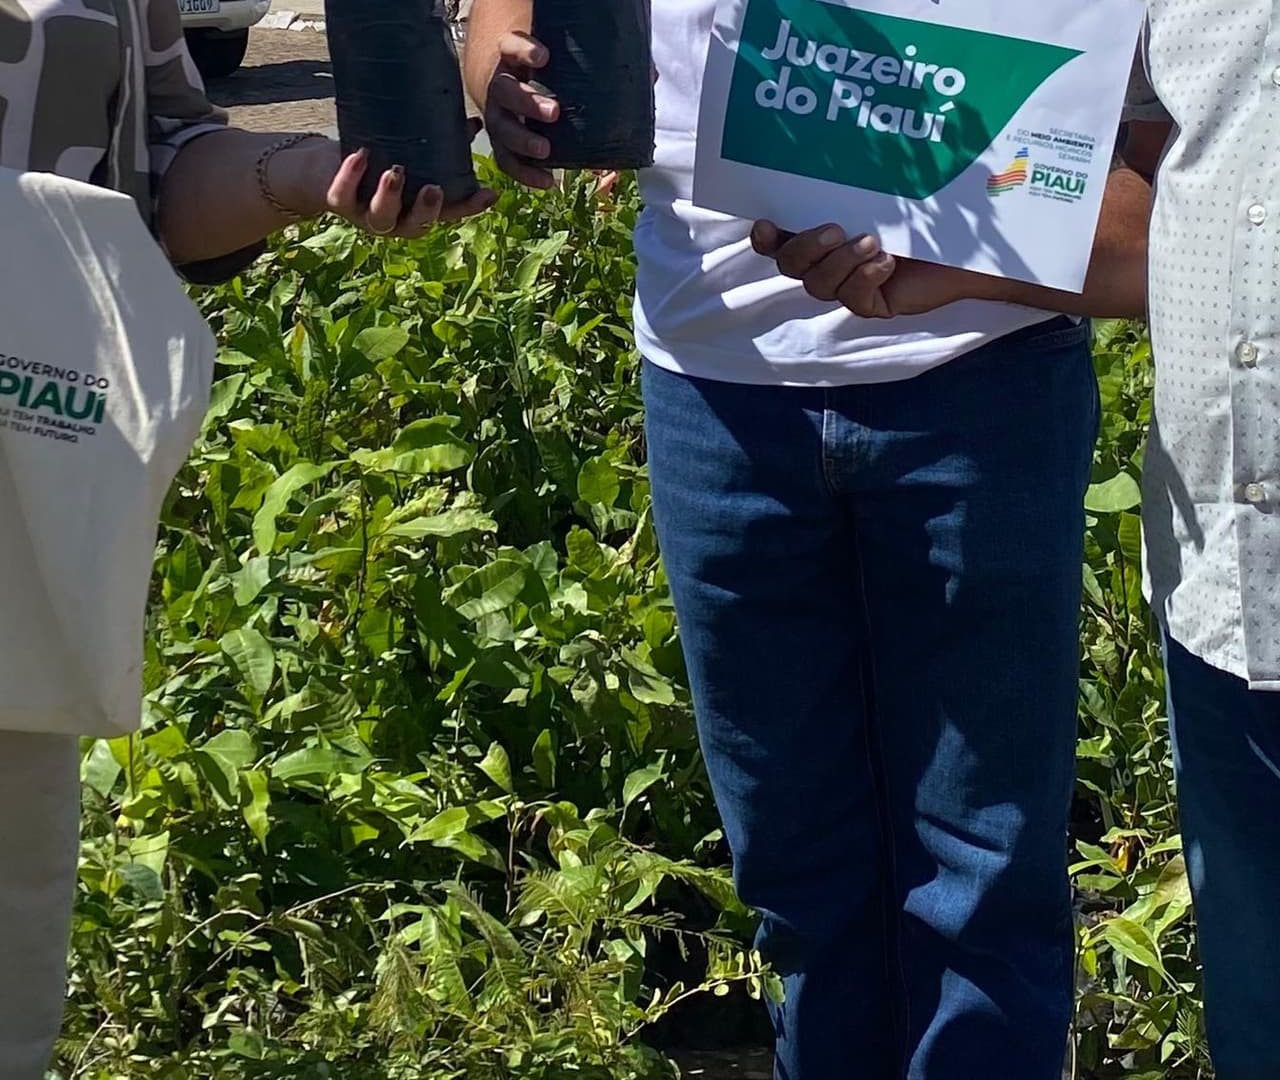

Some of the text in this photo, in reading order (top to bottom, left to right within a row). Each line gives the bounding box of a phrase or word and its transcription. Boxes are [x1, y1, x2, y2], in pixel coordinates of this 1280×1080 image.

[761, 19, 966, 97] Juazeiro
[755, 66, 955, 143] do Piauí
[1031, 132, 1052, 141] MEIO
[1053, 137, 1094, 150] AMBIENTE
[1033, 162, 1089, 179] GOVERNO DO
[84, 374, 109, 389] DO
